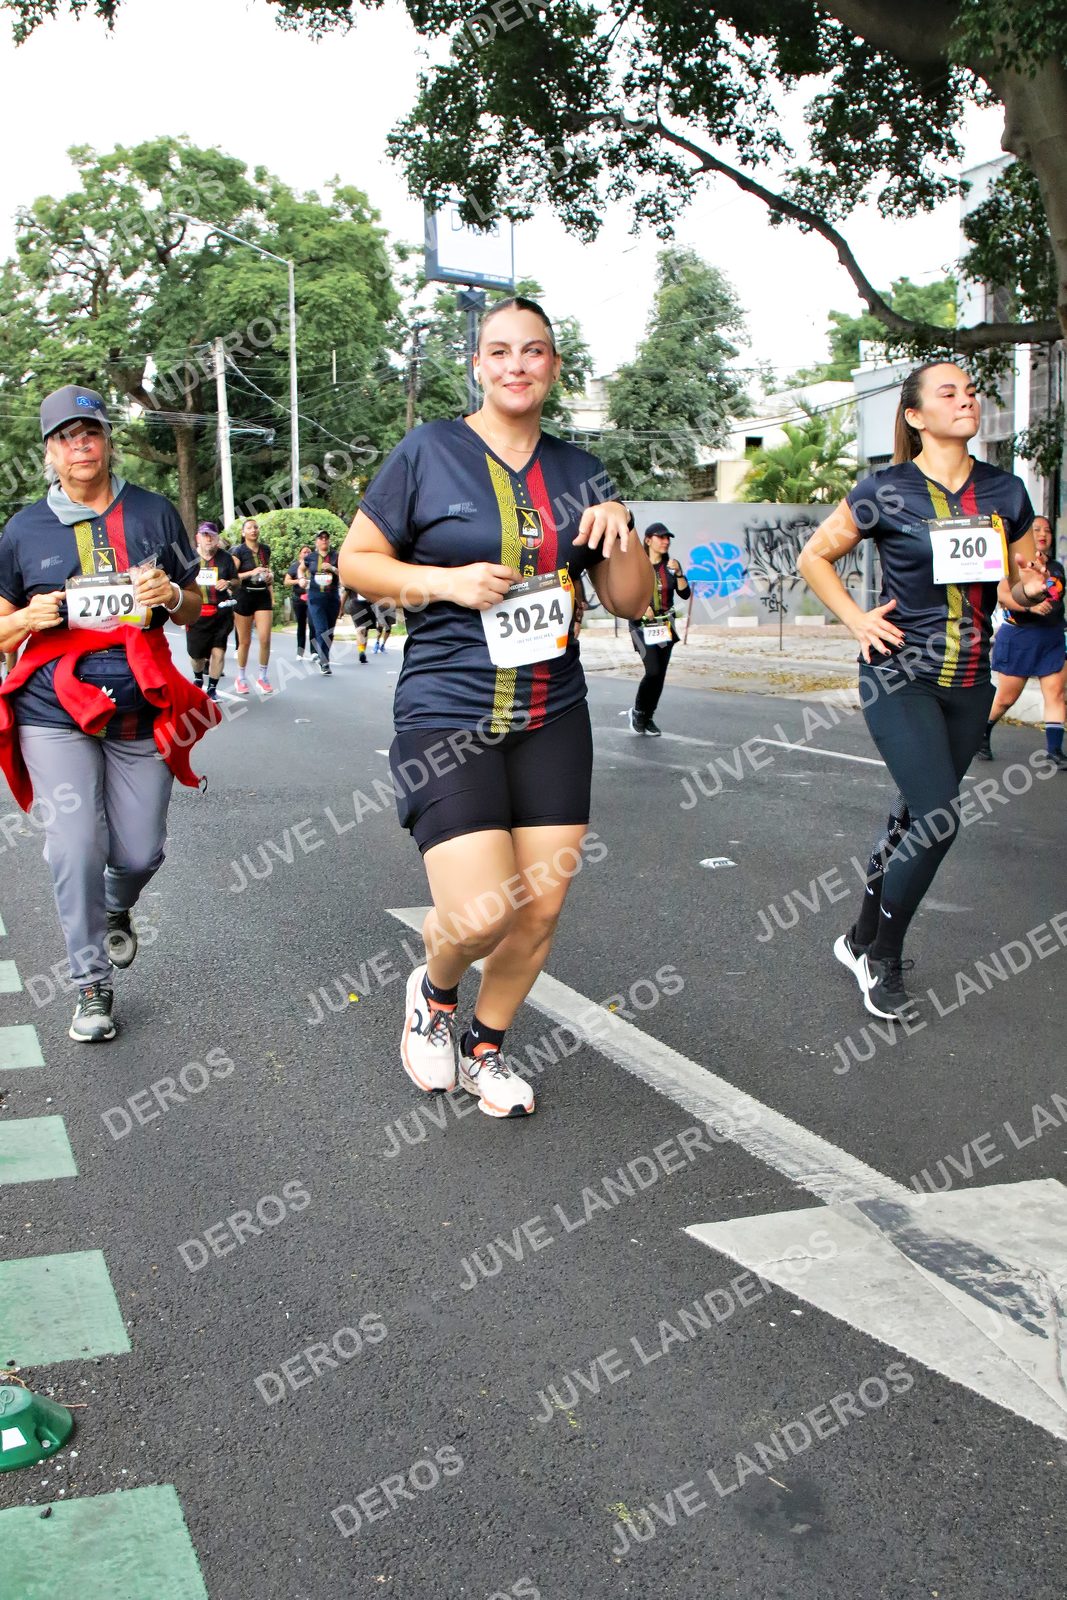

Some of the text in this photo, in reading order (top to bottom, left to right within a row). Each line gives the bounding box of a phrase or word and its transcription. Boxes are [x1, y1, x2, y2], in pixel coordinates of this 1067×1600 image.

[950, 537, 987, 559] 260
[79, 593, 134, 618] 2709
[496, 599, 564, 638] 3024
